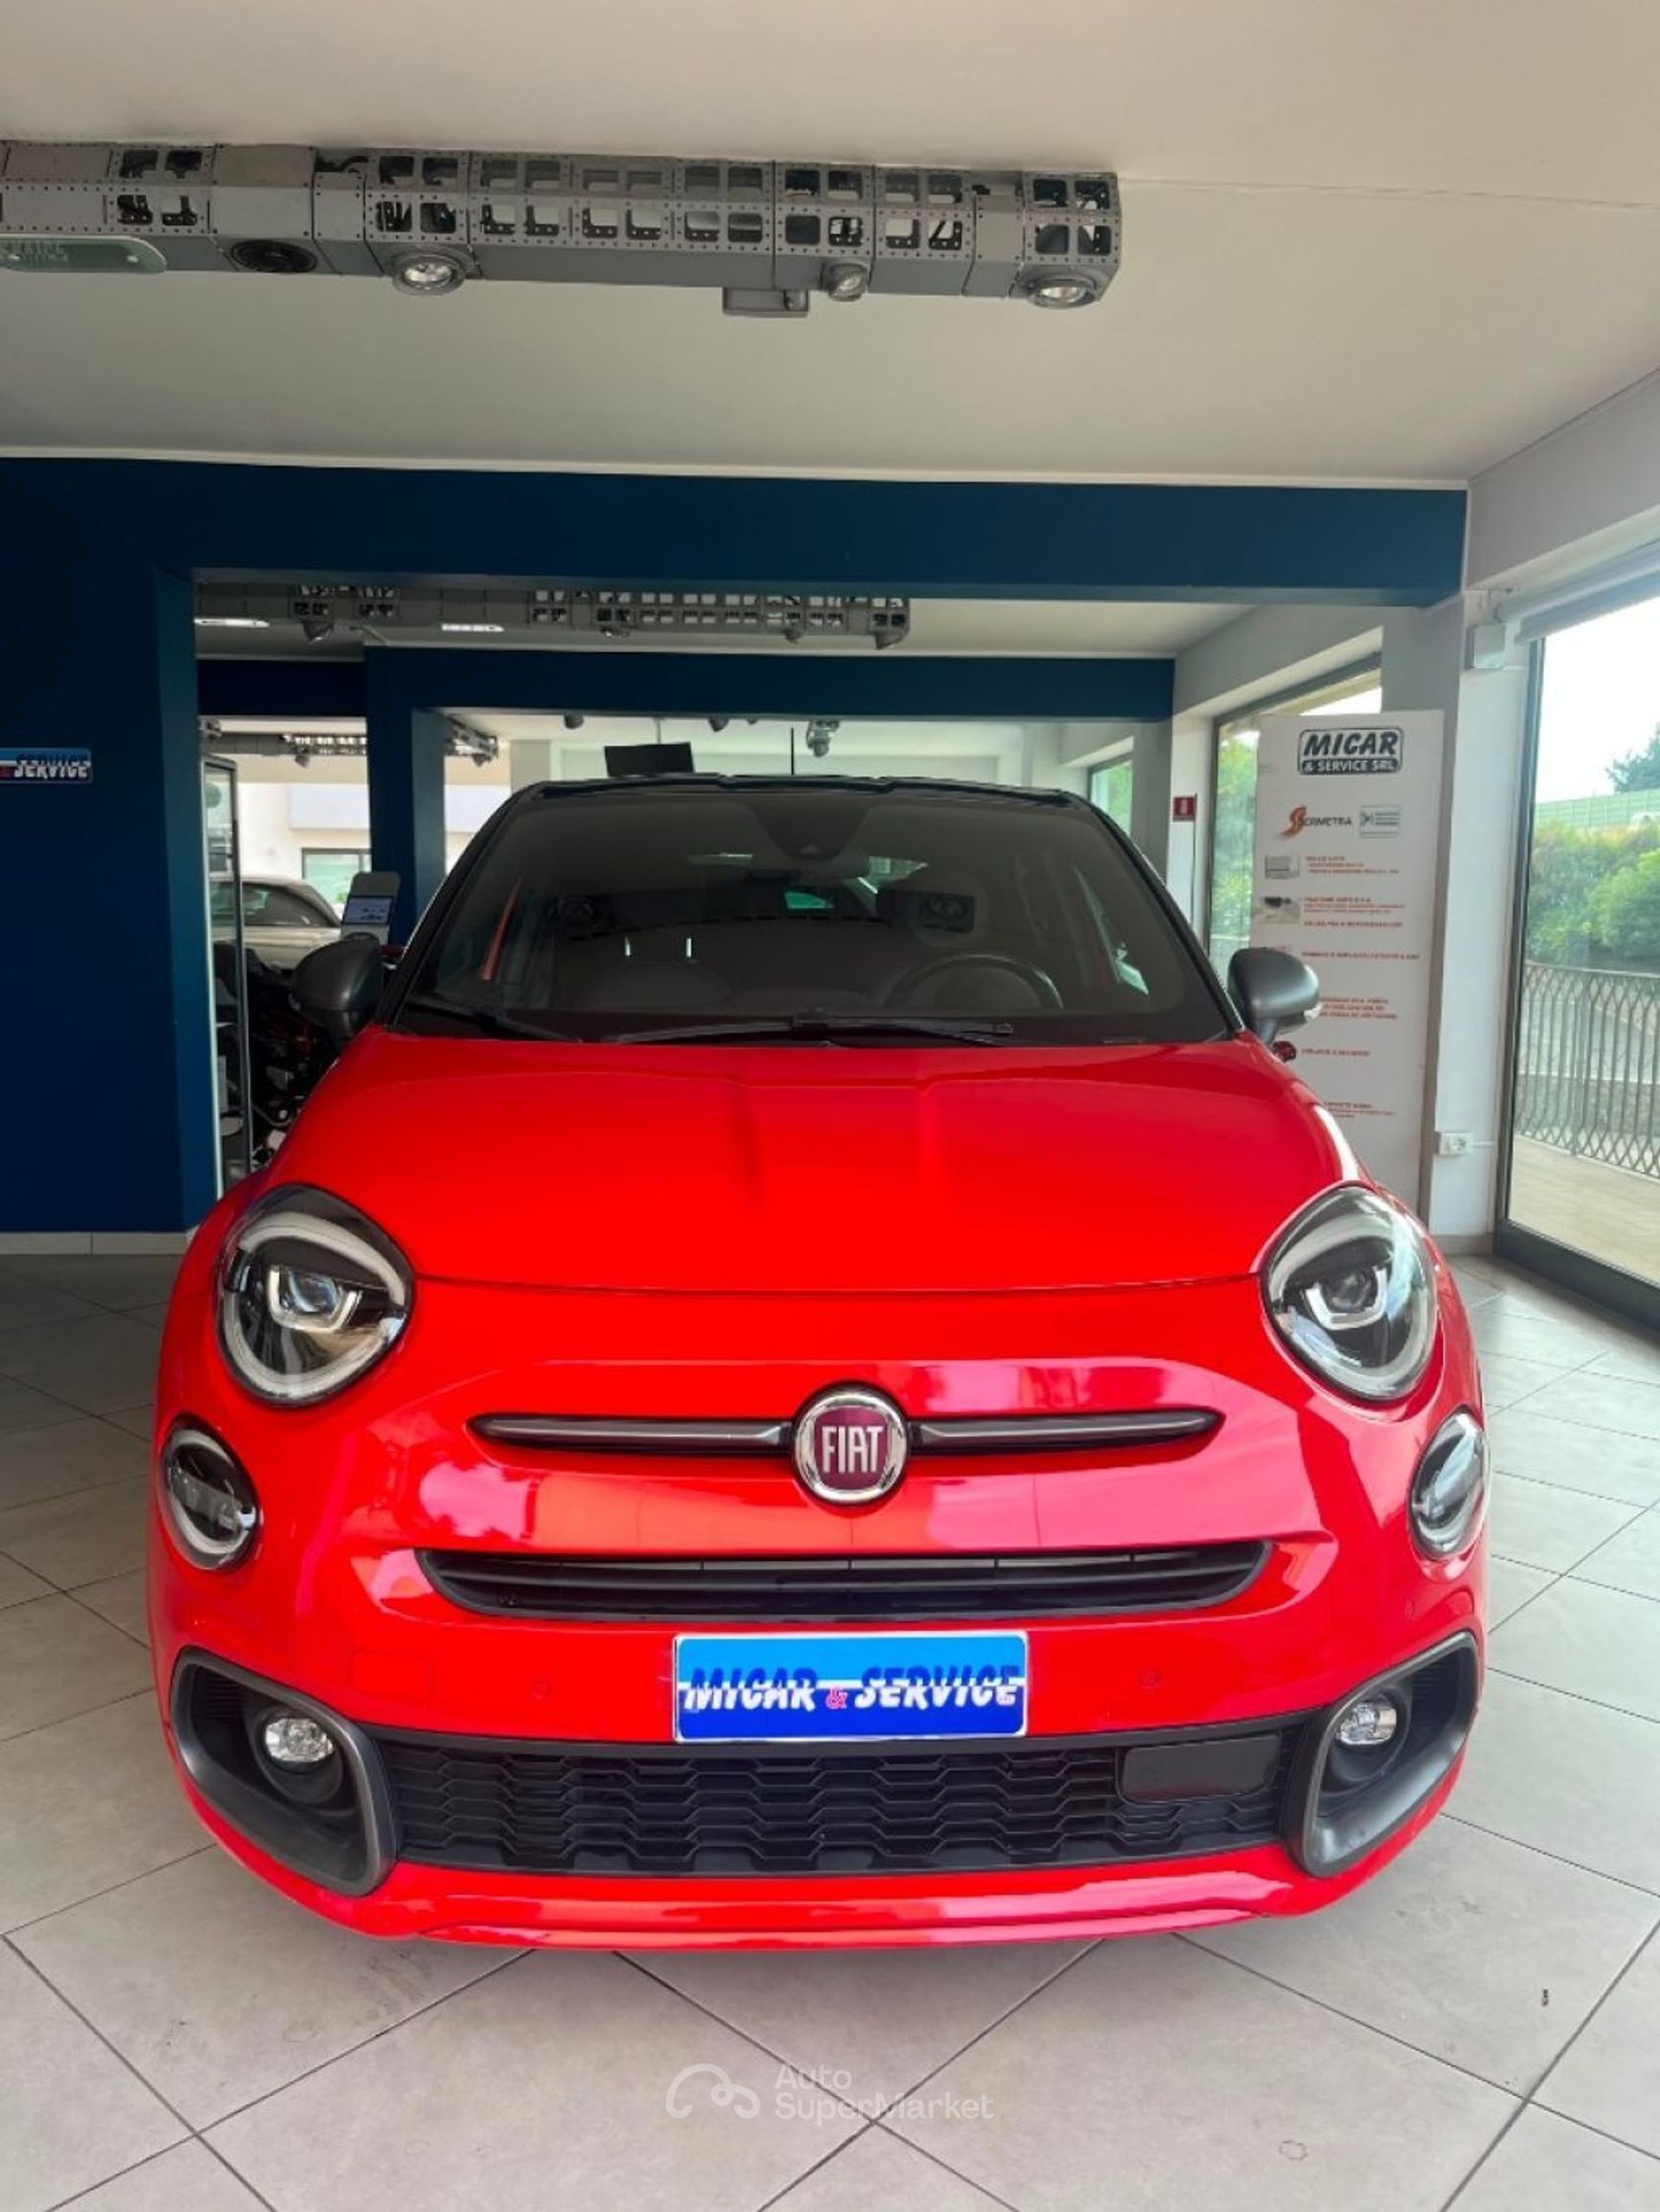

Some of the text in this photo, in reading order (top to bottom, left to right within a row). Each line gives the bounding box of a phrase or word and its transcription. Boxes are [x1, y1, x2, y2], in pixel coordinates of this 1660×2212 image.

[1304, 731, 1399, 756] MICAR
[14, 753, 89, 780] SERVICE
[1317, 760, 1368, 773] SERVICE
[1372, 760, 1395, 772] SRL
[821, 1425, 884, 1474] FIAT
[683, 1664, 1023, 1712] MICAR & SERVICE
